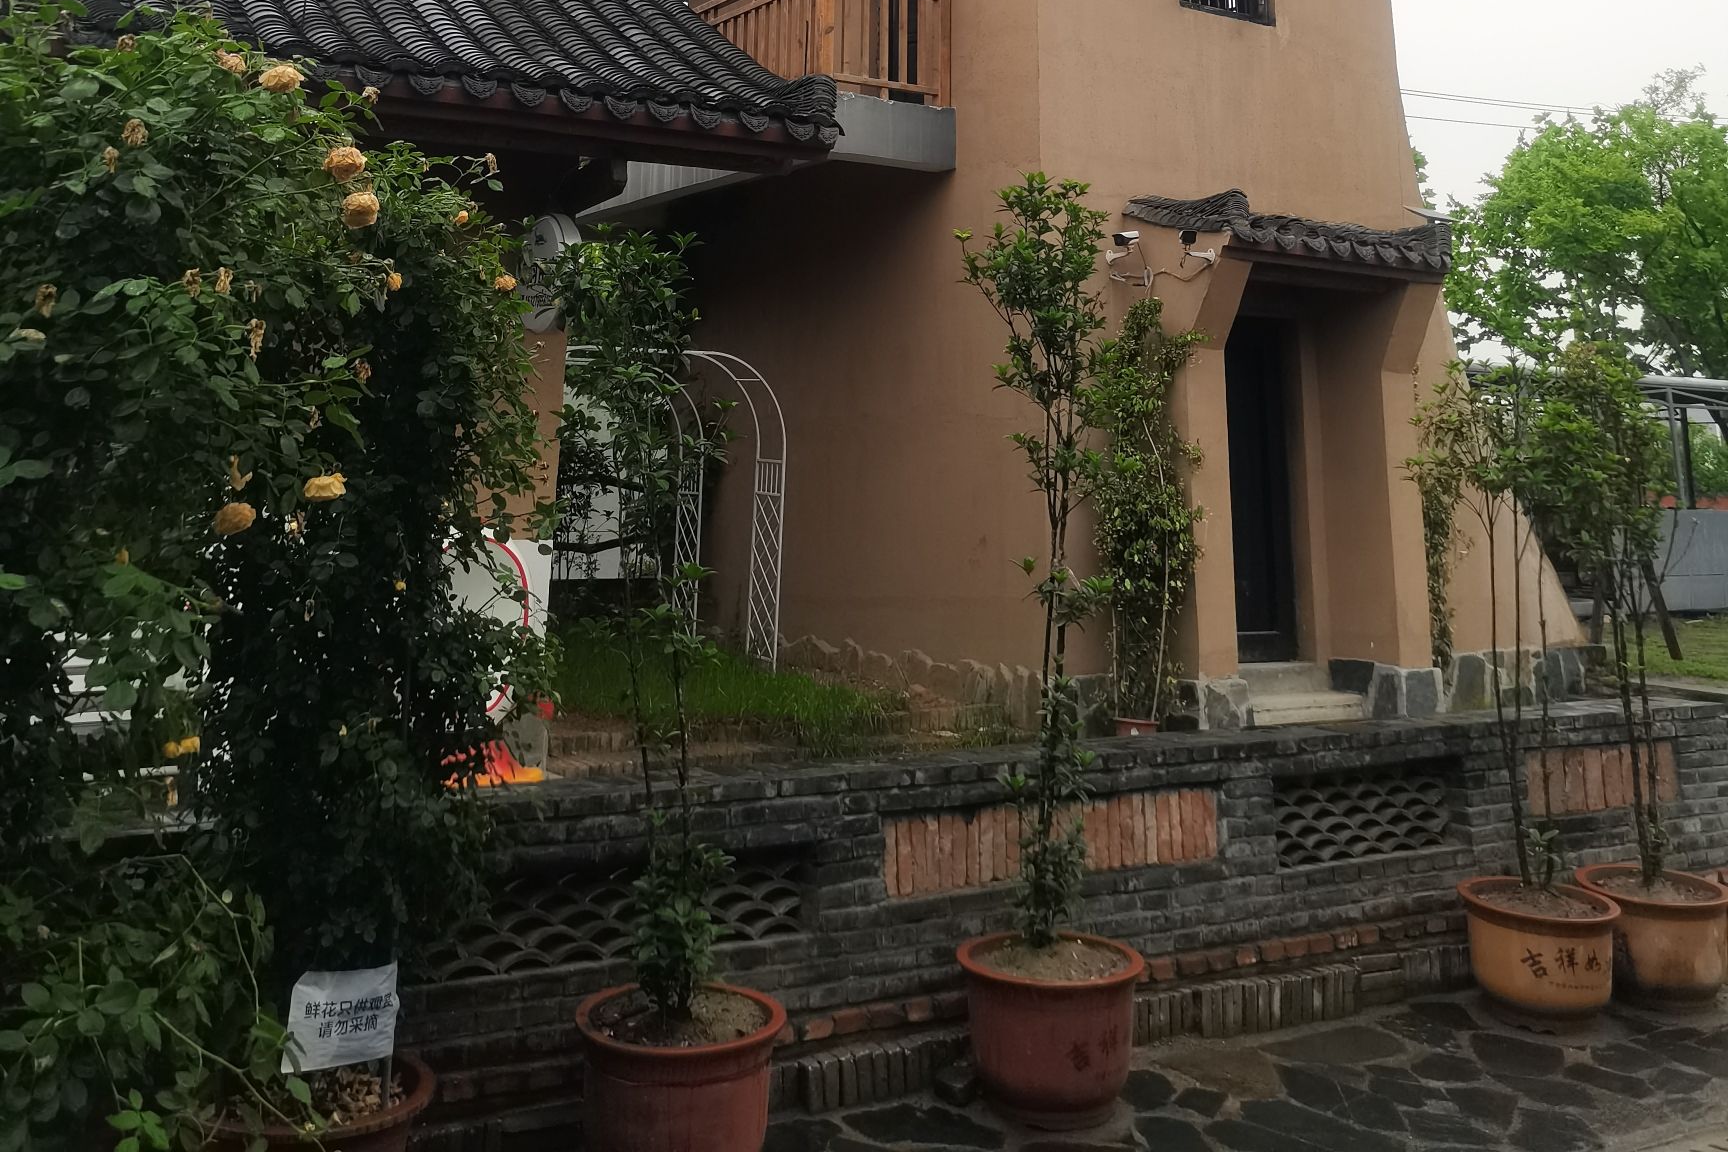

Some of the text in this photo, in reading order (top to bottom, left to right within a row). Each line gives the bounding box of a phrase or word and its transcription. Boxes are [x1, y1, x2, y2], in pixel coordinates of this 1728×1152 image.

[1520, 947, 1612, 980] 吉祥如
[318, 1014, 379, 1039] 请勿采摘
